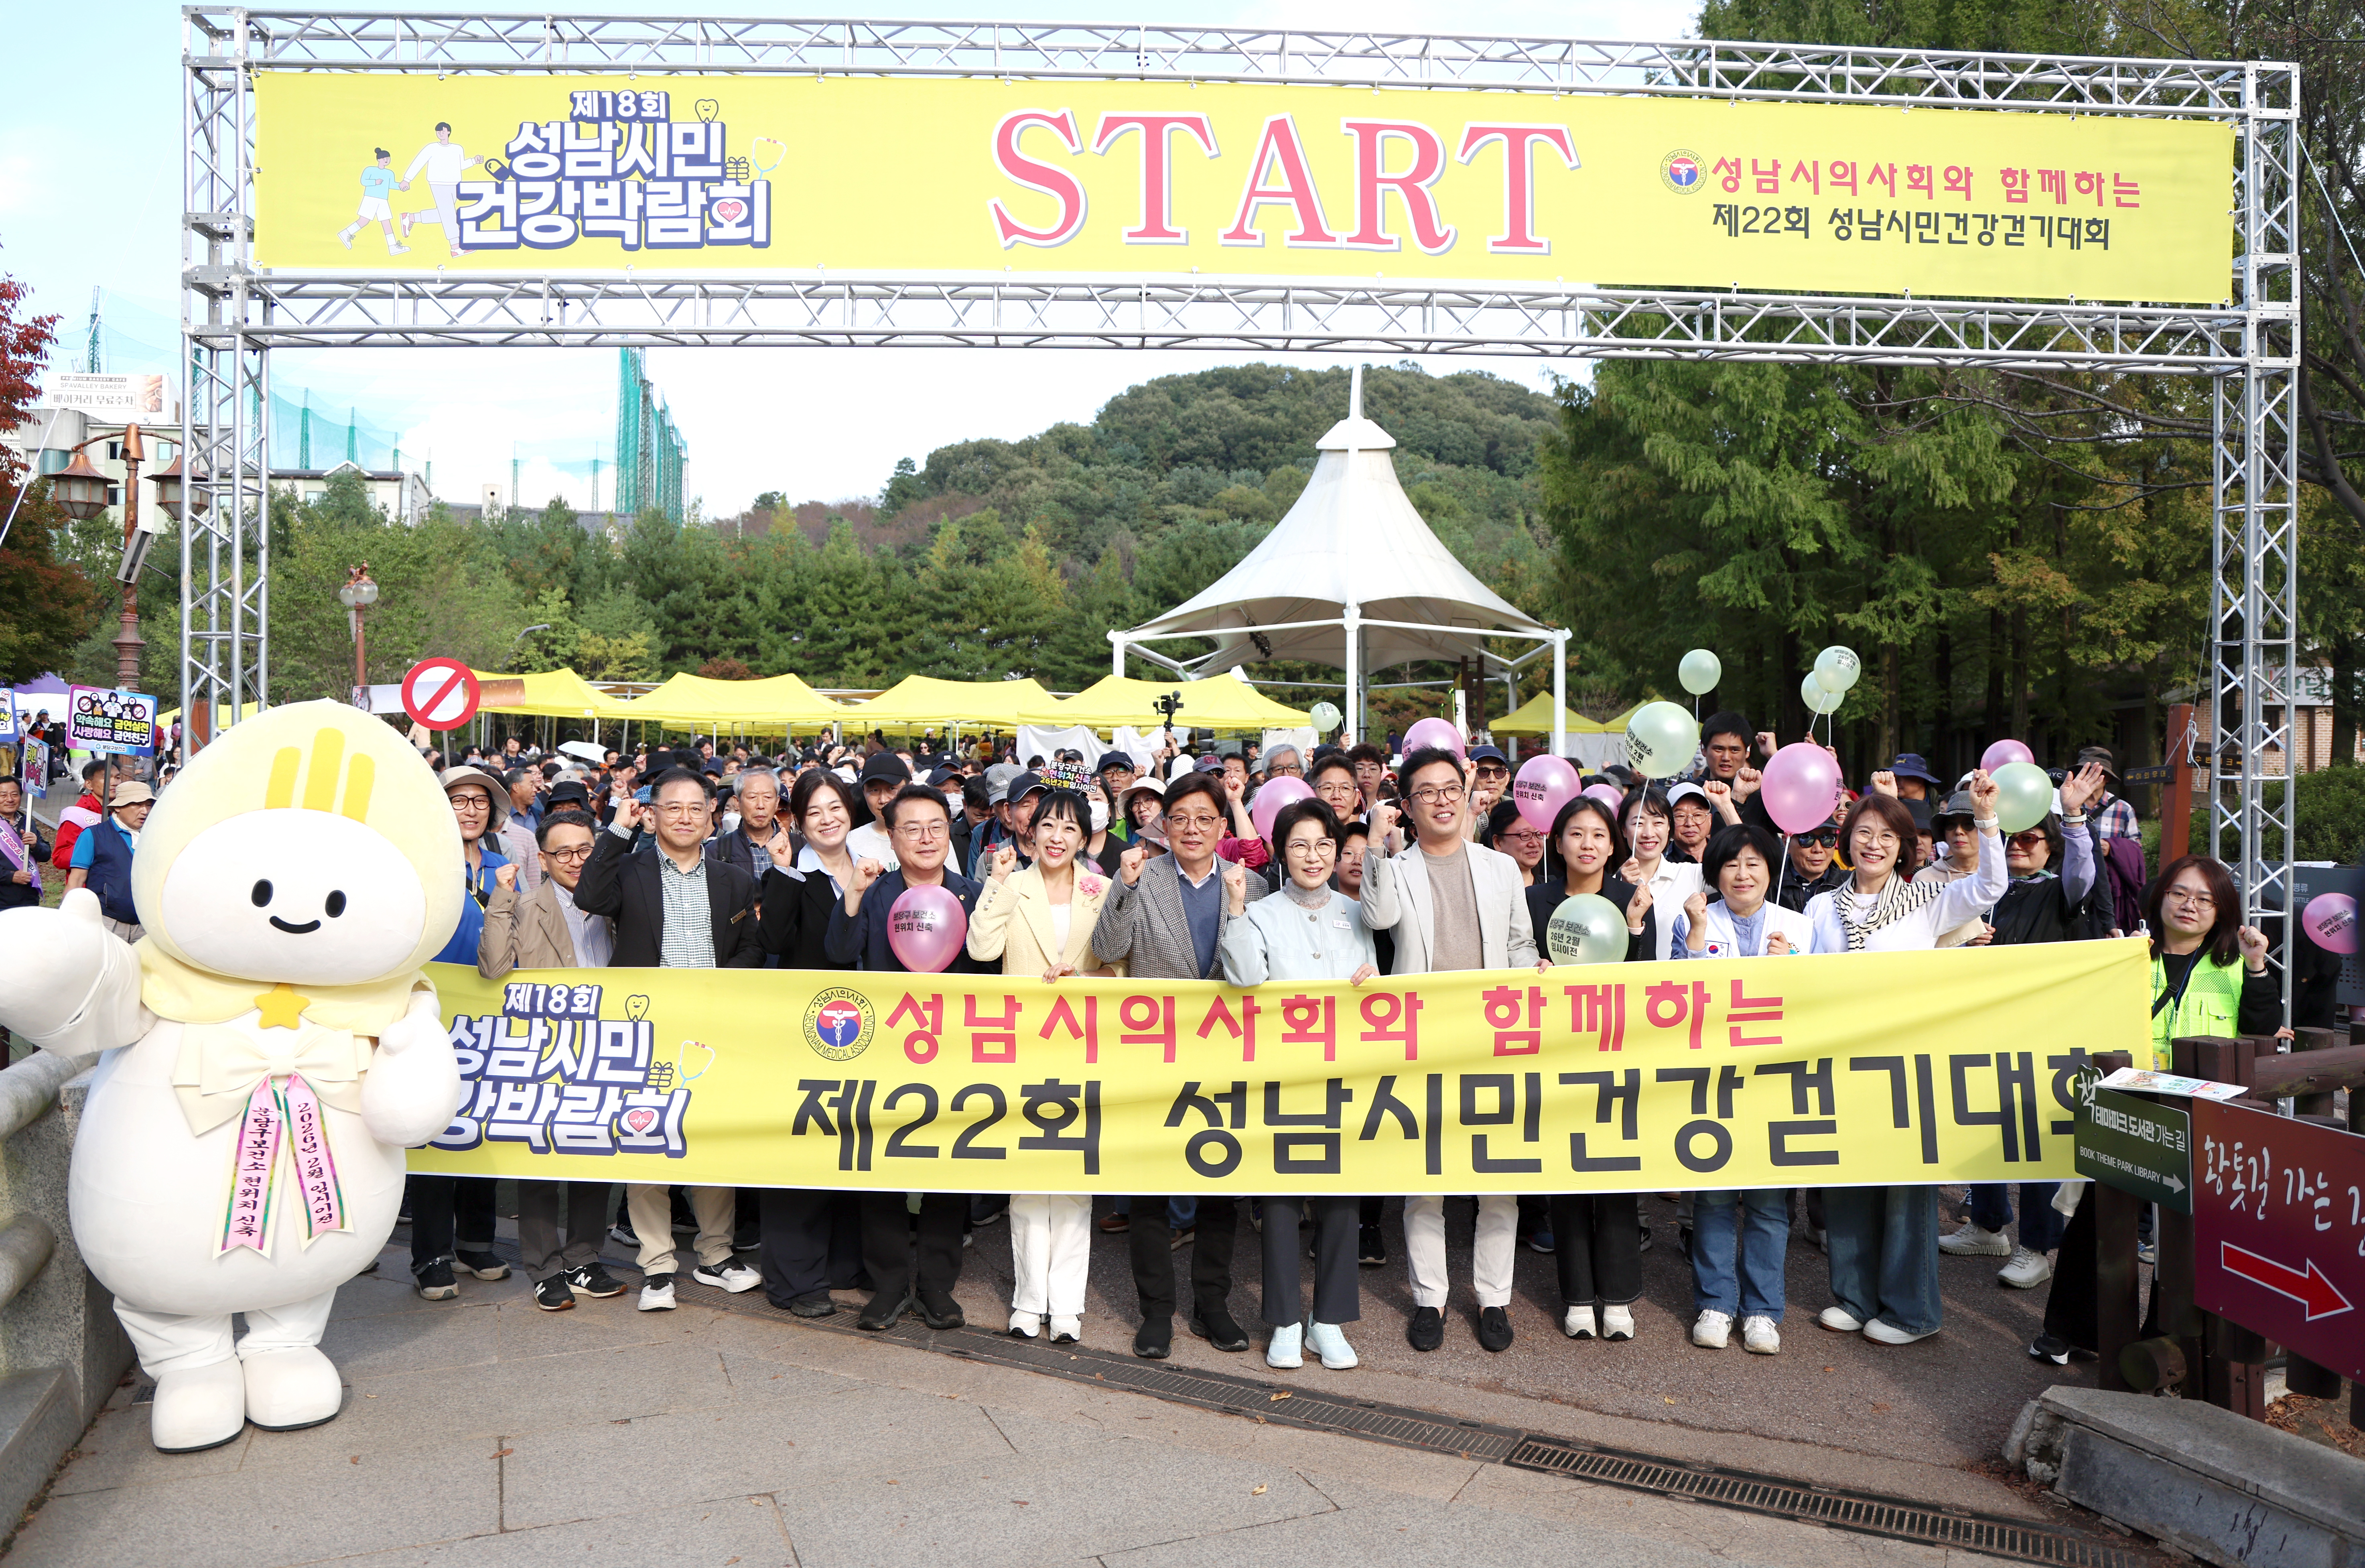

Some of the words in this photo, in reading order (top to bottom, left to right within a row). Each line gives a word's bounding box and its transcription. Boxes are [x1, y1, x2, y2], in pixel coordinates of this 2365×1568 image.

[571, 91, 669, 122] 제18회
[506, 121, 725, 181] 성남시민
[987, 108, 1581, 255] START
[1661, 165, 1675, 189] SEONGNAM
[1673, 185, 1692, 194] MEDICAL
[1691, 167, 1707, 191] ASSOCIATION
[1711, 155, 1974, 202] 성남시의사회와
[2000, 166, 2140, 209] 함께하는
[457, 180, 770, 250] 건강박람회
[1712, 203, 1810, 239] 제22회
[1828, 207, 2110, 251] 성남시민건강걷기대회
[53, 394, 92, 404] 베이커리
[96, 395, 134, 405] 무료주차
[74, 726, 112, 739] 사랑해요
[114, 730, 148, 743] 금연친구
[75, 714, 112, 728] 약속해요
[114, 719, 150, 733] 금연실천
[27, 744, 37, 763] 금연
[1634, 737, 1653, 757] 보건소
[1634, 749, 1644, 761] 2월
[1051, 761, 1092, 775] 분당구보건소
[2195, 756, 2233, 766] 수변크
[1516, 790, 1529, 799] 현위치
[1531, 792, 1544, 801] 신축
[1528, 782, 1547, 792] 보건소
[893, 910, 911, 922] 분당구
[912, 910, 936, 920] 보건소
[894, 922, 914, 933] 현위치
[916, 922, 933, 932] 신축
[1549, 918, 1565, 930] 분당구
[1564, 920, 1591, 937] 보건소
[2316, 918, 2333, 932] 분당구
[2332, 909, 2350, 922] 보건소
[1551, 931, 1564, 943] 26년
[1566, 935, 1581, 947] 2월
[2324, 924, 2342, 938] 현위치
[1551, 942, 1577, 957] 임시이전
[504, 983, 603, 1018] 제18회
[813, 989, 868, 1010] 성남시의사회
[885, 991, 1423, 1064] 성남시의사회와
[1482, 979, 1783, 1056] 함께하는
[804, 1014, 824, 1052] SEONGNAM
[821, 1045, 851, 1060] MEDICAL
[850, 1015, 874, 1056] ASSOCIATION
[449, 1014, 654, 1085] 성남시민
[297, 1102, 318, 1154] 2026년
[792, 1078, 1101, 1175] 제22회
[2095, 1105, 2127, 1133] 테마파크
[2129, 1115, 2154, 1143] 도서관
[2156, 1124, 2174, 1149] 가는
[2176, 1129, 2186, 1152] 길
[242, 1106, 275, 1171] 분당구보건소
[307, 1157, 324, 1179] 2월
[2080, 1146, 2095, 1160] BOOK
[2096, 1152, 2116, 1168] THEME
[2117, 1159, 2134, 1174] PARK
[2134, 1165, 2160, 1183] LIBRARY
[239, 1176, 262, 1211] 현위치
[2205, 1135, 2270, 1221] 황톳길
[2284, 1167, 2332, 1231] 가는
[311, 1181, 333, 1225] 임시이전
[233, 1214, 258, 1237] 신축
[535, 1282, 546, 1297] N
[575, 1272, 592, 1288] N
